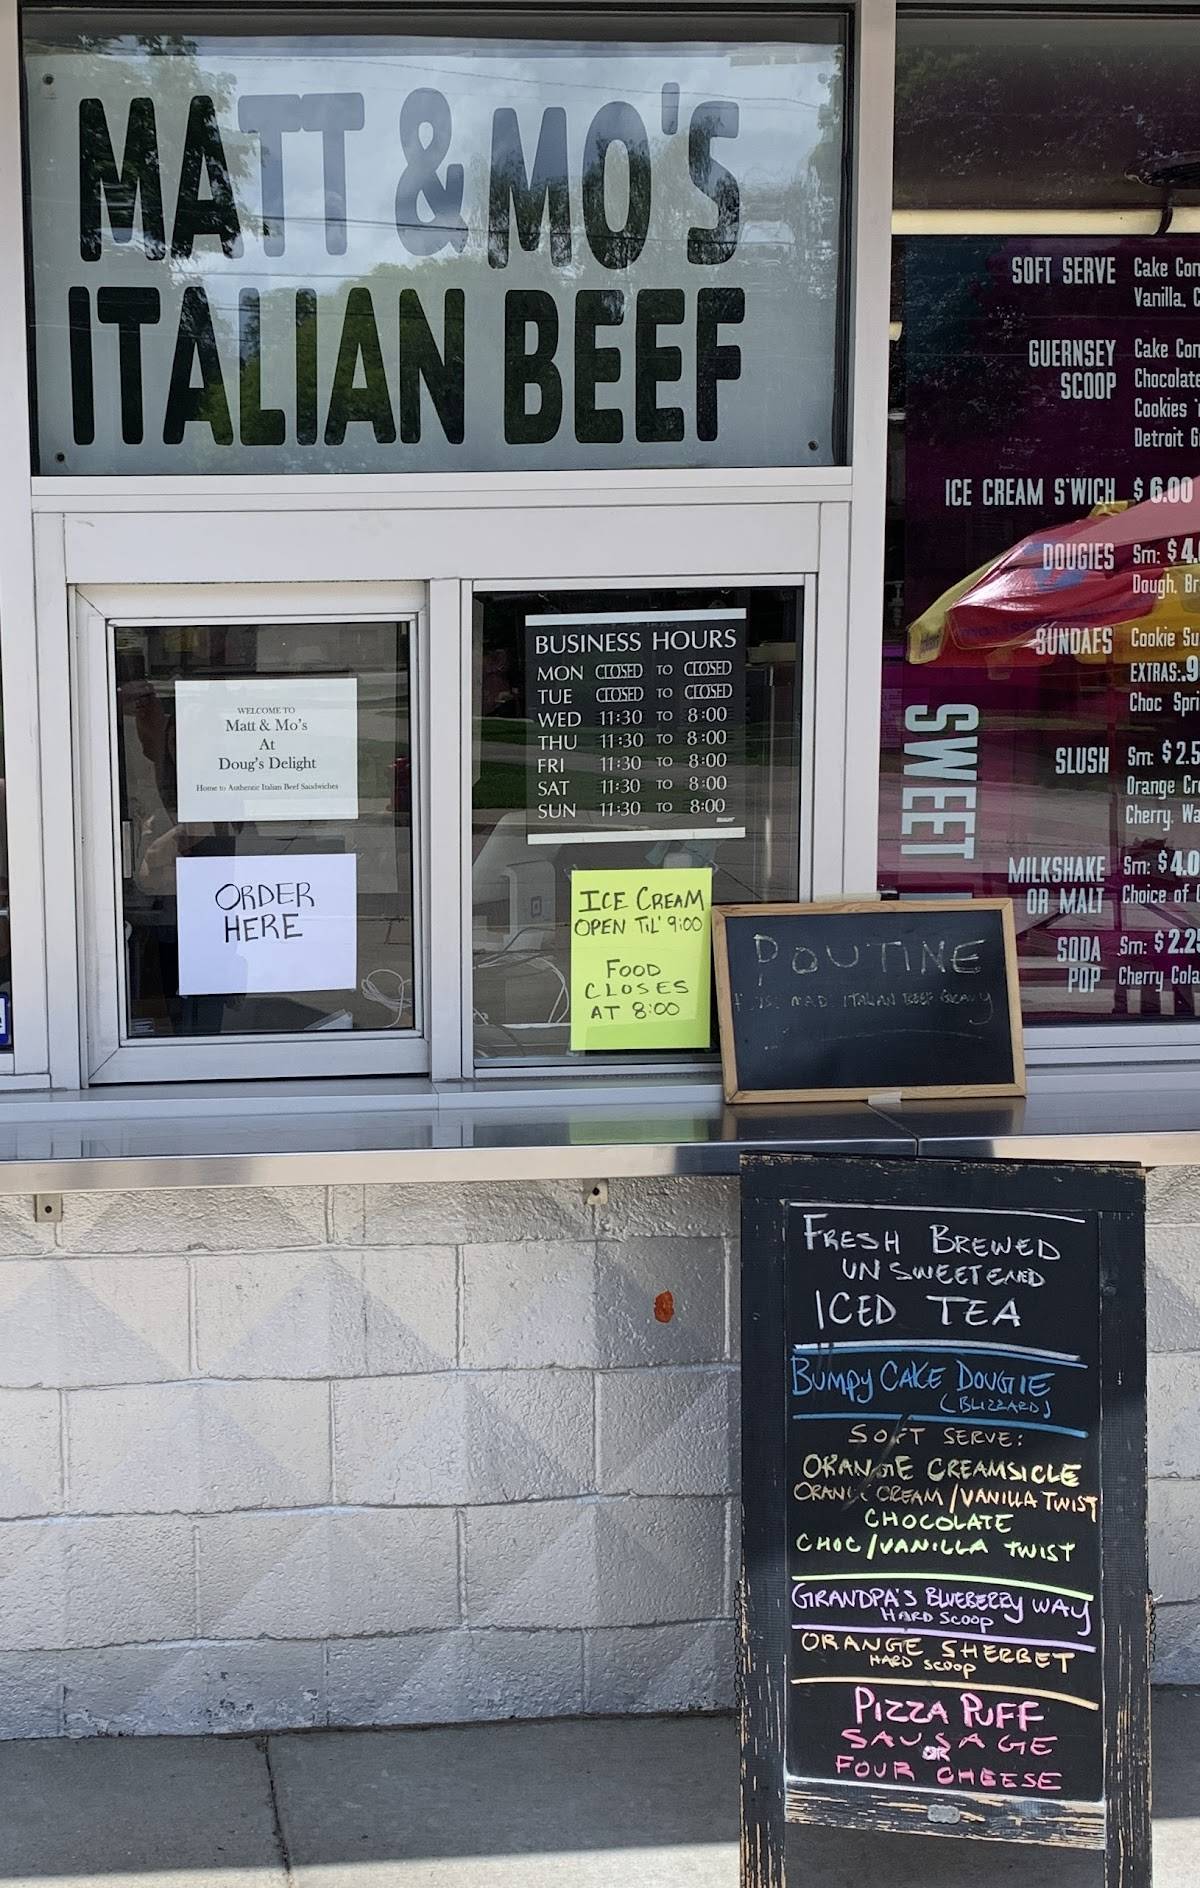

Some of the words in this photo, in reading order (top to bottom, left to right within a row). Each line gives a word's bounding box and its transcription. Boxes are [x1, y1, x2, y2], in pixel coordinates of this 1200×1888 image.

[79, 92, 364, 262] MATT
[396, 87, 466, 256] &
[488, 82, 740, 270] MO'S
[1012, 256, 1051, 285] SOFT
[1062, 256, 1116, 284] SERVE
[1134, 256, 1168, 277] Cake
[1029, 339, 1116, 367] GUERNSEY
[1135, 338, 1168, 358] Cake
[68, 286, 465, 446] ITALIAN
[504, 287, 746, 445] BEEF
[1060, 371, 1116, 400] SCOOP
[1135, 397, 1187, 418] Cookies
[1135, 426, 1184, 448] Detroit
[945, 478, 972, 506] ICE
[982, 478, 1044, 505] CREAM
[1054, 477, 1116, 505] S'WICH
[1043, 543, 1115, 571] DOUGIES
[1133, 543, 1161, 564] Sm:
[535, 632, 642, 655] BUSINESS
[652, 629, 737, 650] HOURS
[1035, 627, 1113, 656] SUNDAES
[1131, 625, 1176, 648] Cookie
[537, 665, 584, 681] MON
[595, 663, 643, 680] CLOSED
[656, 664, 673, 676] TO
[684, 660, 732, 677] CLOSED
[537, 688, 573, 705] TUE
[595, 686, 644, 703] CLOSED
[656, 687, 673, 699] TO
[684, 683, 733, 700] CLOSED
[1129, 691, 1162, 712] Choc
[237, 707, 282, 715] WELCOME
[538, 711, 582, 728] WED
[601, 709, 643, 726] 11:30
[656, 710, 673, 722] TO
[687, 706, 728, 723] 8:00
[225, 719, 256, 732] Matt
[259, 719, 271, 732] &
[275, 718, 308, 731] Mo's
[259, 738, 276, 751] At
[538, 734, 577, 751] THU
[600, 732, 644, 749] 11:30
[656, 733, 673, 745] TO
[687, 729, 727, 746] 8:00
[218, 757, 265, 772] Doug's
[269, 756, 317, 771] Delight
[538, 758, 564, 774] FRI
[601, 755, 642, 772] 11:30
[656, 756, 673, 768] TO
[688, 752, 727, 769] 8:00
[1055, 747, 1110, 775] SLUSH
[1127, 746, 1154, 767] Sm:
[196, 784, 217, 792] Home
[261, 783, 282, 791] Italian
[284, 783, 300, 791] Beef
[301, 782, 339, 791] Sandwiches
[538, 780, 570, 796] SAT
[601, 778, 641, 795] 11:30
[656, 779, 673, 790] TO
[688, 775, 727, 792] 8:00
[901, 703, 979, 860] SWEET
[1127, 775, 1176, 800] Orange
[538, 803, 577, 819] SUN
[600, 801, 641, 817] 11:30
[656, 801, 673, 813] TO
[689, 798, 726, 814] 8:00
[1008, 856, 1106, 884] MILKSHAKE
[1123, 855, 1151, 876] Sm:
[215, 881, 315, 911] ORDER
[578, 890, 628, 912] ICE
[636, 886, 705, 911] CREAM
[1026, 888, 1049, 915] OR
[1059, 887, 1105, 915] MALT
[1122, 883, 1167, 904] Choice
[1173, 883, 1190, 904] of
[225, 913, 303, 943] HERE
[574, 918, 626, 937] OPEN
[667, 915, 703, 933] 9:00
[1056, 935, 1101, 963] SODA
[1120, 935, 1148, 955] Sm:
[606, 958, 661, 978] FOOD
[753, 933, 987, 987] POUTINE
[585, 980, 689, 1000] CLOSES
[1068, 967, 1101, 994] POP
[1118, 965, 1164, 992] Cherry
[590, 1005, 620, 1020] AT
[631, 1001, 680, 1020] 8:00
[803, 1213, 901, 1255] FRESH
[929, 1224, 1062, 1261] BREWED
[815, 1290, 897, 1330] ICED
[926, 1295, 1021, 1328] TEA
[790, 1355, 873, 1404] BUMPY
[879, 1360, 947, 1392] CAKE
[956, 1360, 1056, 1397] DOUGIE
[848, 1423, 926, 1445] SOFT
[943, 1427, 1024, 1446] SERVE:
[802, 1453, 914, 1481] ORANGE
[927, 1458, 1082, 1488] CREAMSICLE
[1043, 1490, 1099, 1523] TWIST
[864, 1507, 1014, 1534] CHOCOLATE
[1004, 1540, 1076, 1563] TWIST
[792, 1582, 917, 1609] GRANDPA'S
[1032, 1598, 1091, 1637] WAY
[881, 1607, 933, 1622] HARD
[939, 1611, 994, 1631] SCOOP
[802, 1632, 924, 1657] ORANGE
[941, 1640, 1075, 1674] SHERBET
[869, 1654, 913, 1668] HARD
[923, 1659, 976, 1680] SCOOP
[854, 1686, 950, 1726] PIZZA
[960, 1692, 1045, 1732] PUFF
[841, 1728, 1058, 1756] SAUSAGE
[922, 1746, 950, 1761] OR
[835, 1755, 915, 1782] FOUR
[936, 1765, 1064, 1791] CHEESE
